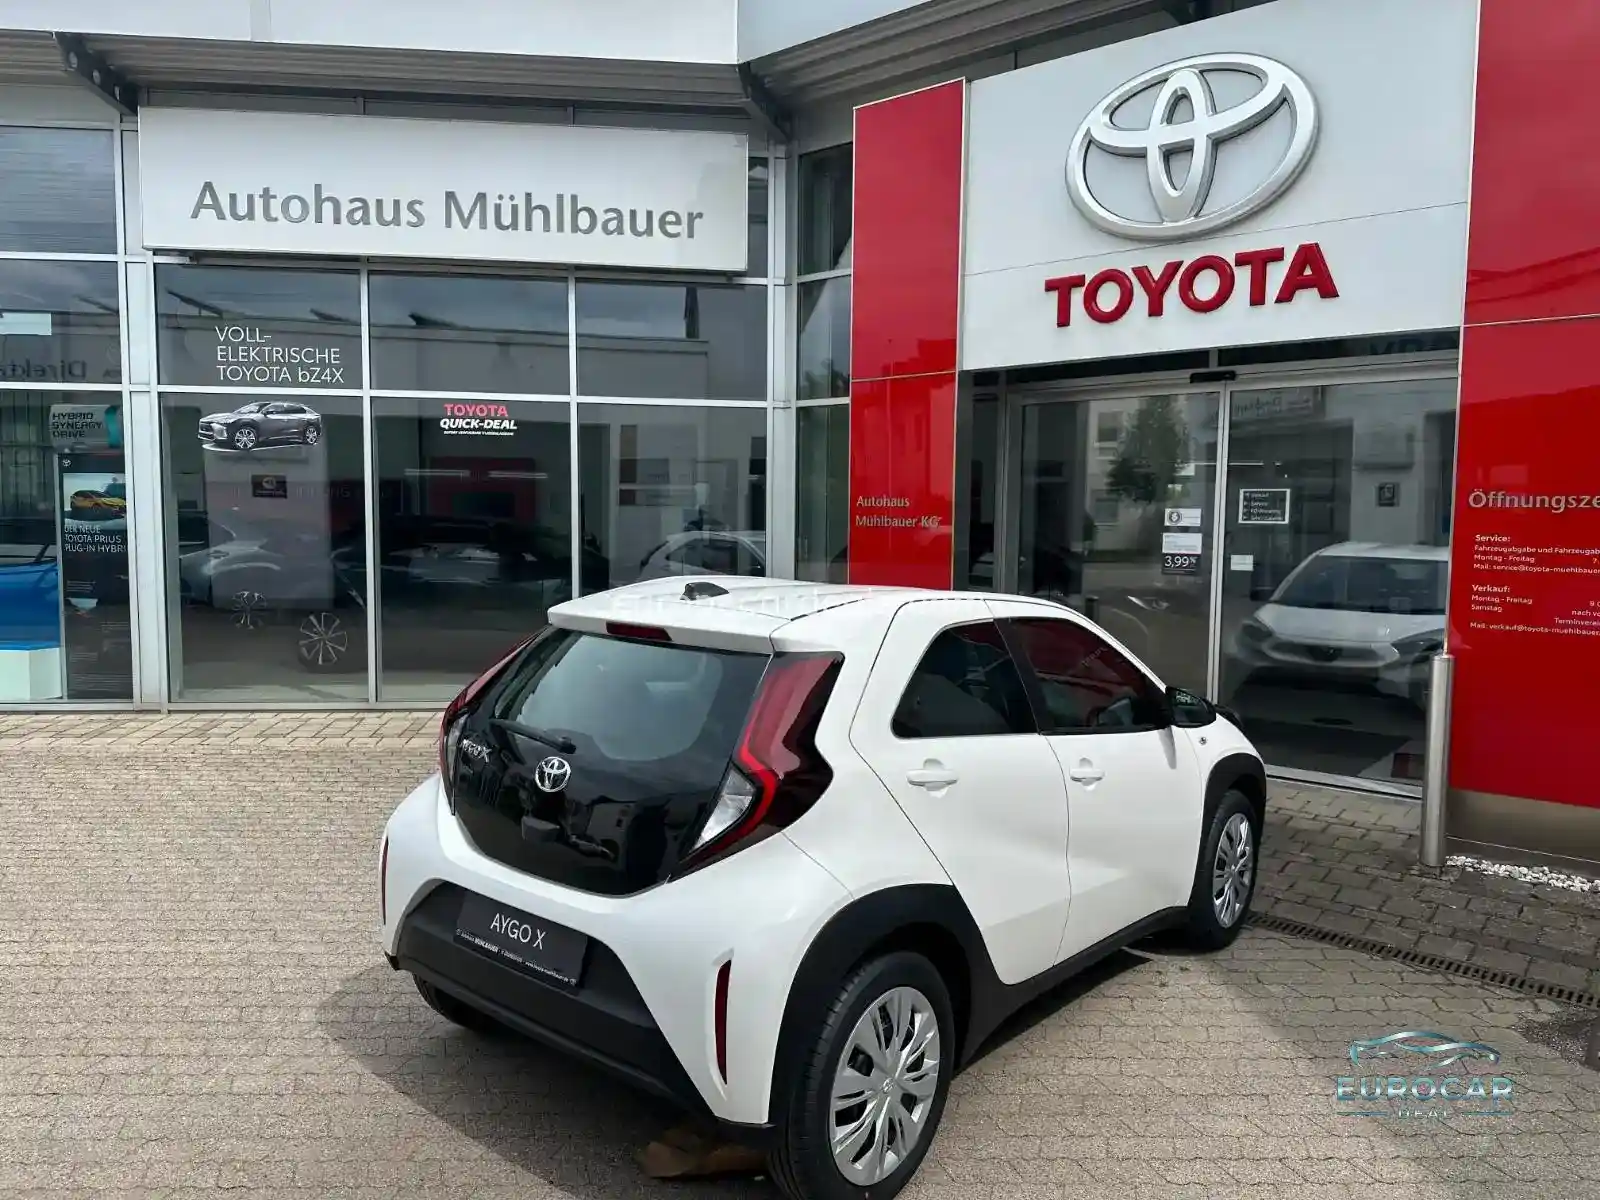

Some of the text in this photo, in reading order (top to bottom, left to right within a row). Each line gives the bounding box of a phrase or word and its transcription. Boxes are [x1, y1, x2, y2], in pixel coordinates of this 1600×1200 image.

[190, 181, 704, 239] Autohaus Mühlbauer
[1044, 242, 1340, 328] TOYOTA
[215, 325, 272, 343] VOLL-
[216, 345, 341, 364] ELEKTRISCHE
[216, 365, 345, 384] TOYOTA bZ4X
[443, 403, 509, 417] TOYOTA
[52, 412, 94, 420] HYBRID
[52, 421, 104, 430] SYNERGY
[440, 418, 518, 430] QUICK-DEAL
[856, 494, 911, 507] Autohaus
[1469, 488, 1600, 513] Öffnungsze
[64, 525, 101, 534] DER NEUE
[64, 534, 122, 544] TOYOTA PRIUS
[1474, 534, 1511, 542] Service:
[64, 544, 96, 552] PLUG-IN
[1474, 544, 1537, 554] Fahrzeugabgabe
[1473, 554, 1503, 562] Montag
[1471, 584, 1510, 592] Verkauf:
[1471, 595, 1500, 603] Montag
[1506, 596, 1533, 605] Freitag
[1471, 604, 1503, 613] Samstag
[489, 912, 547, 951] AYGO X
